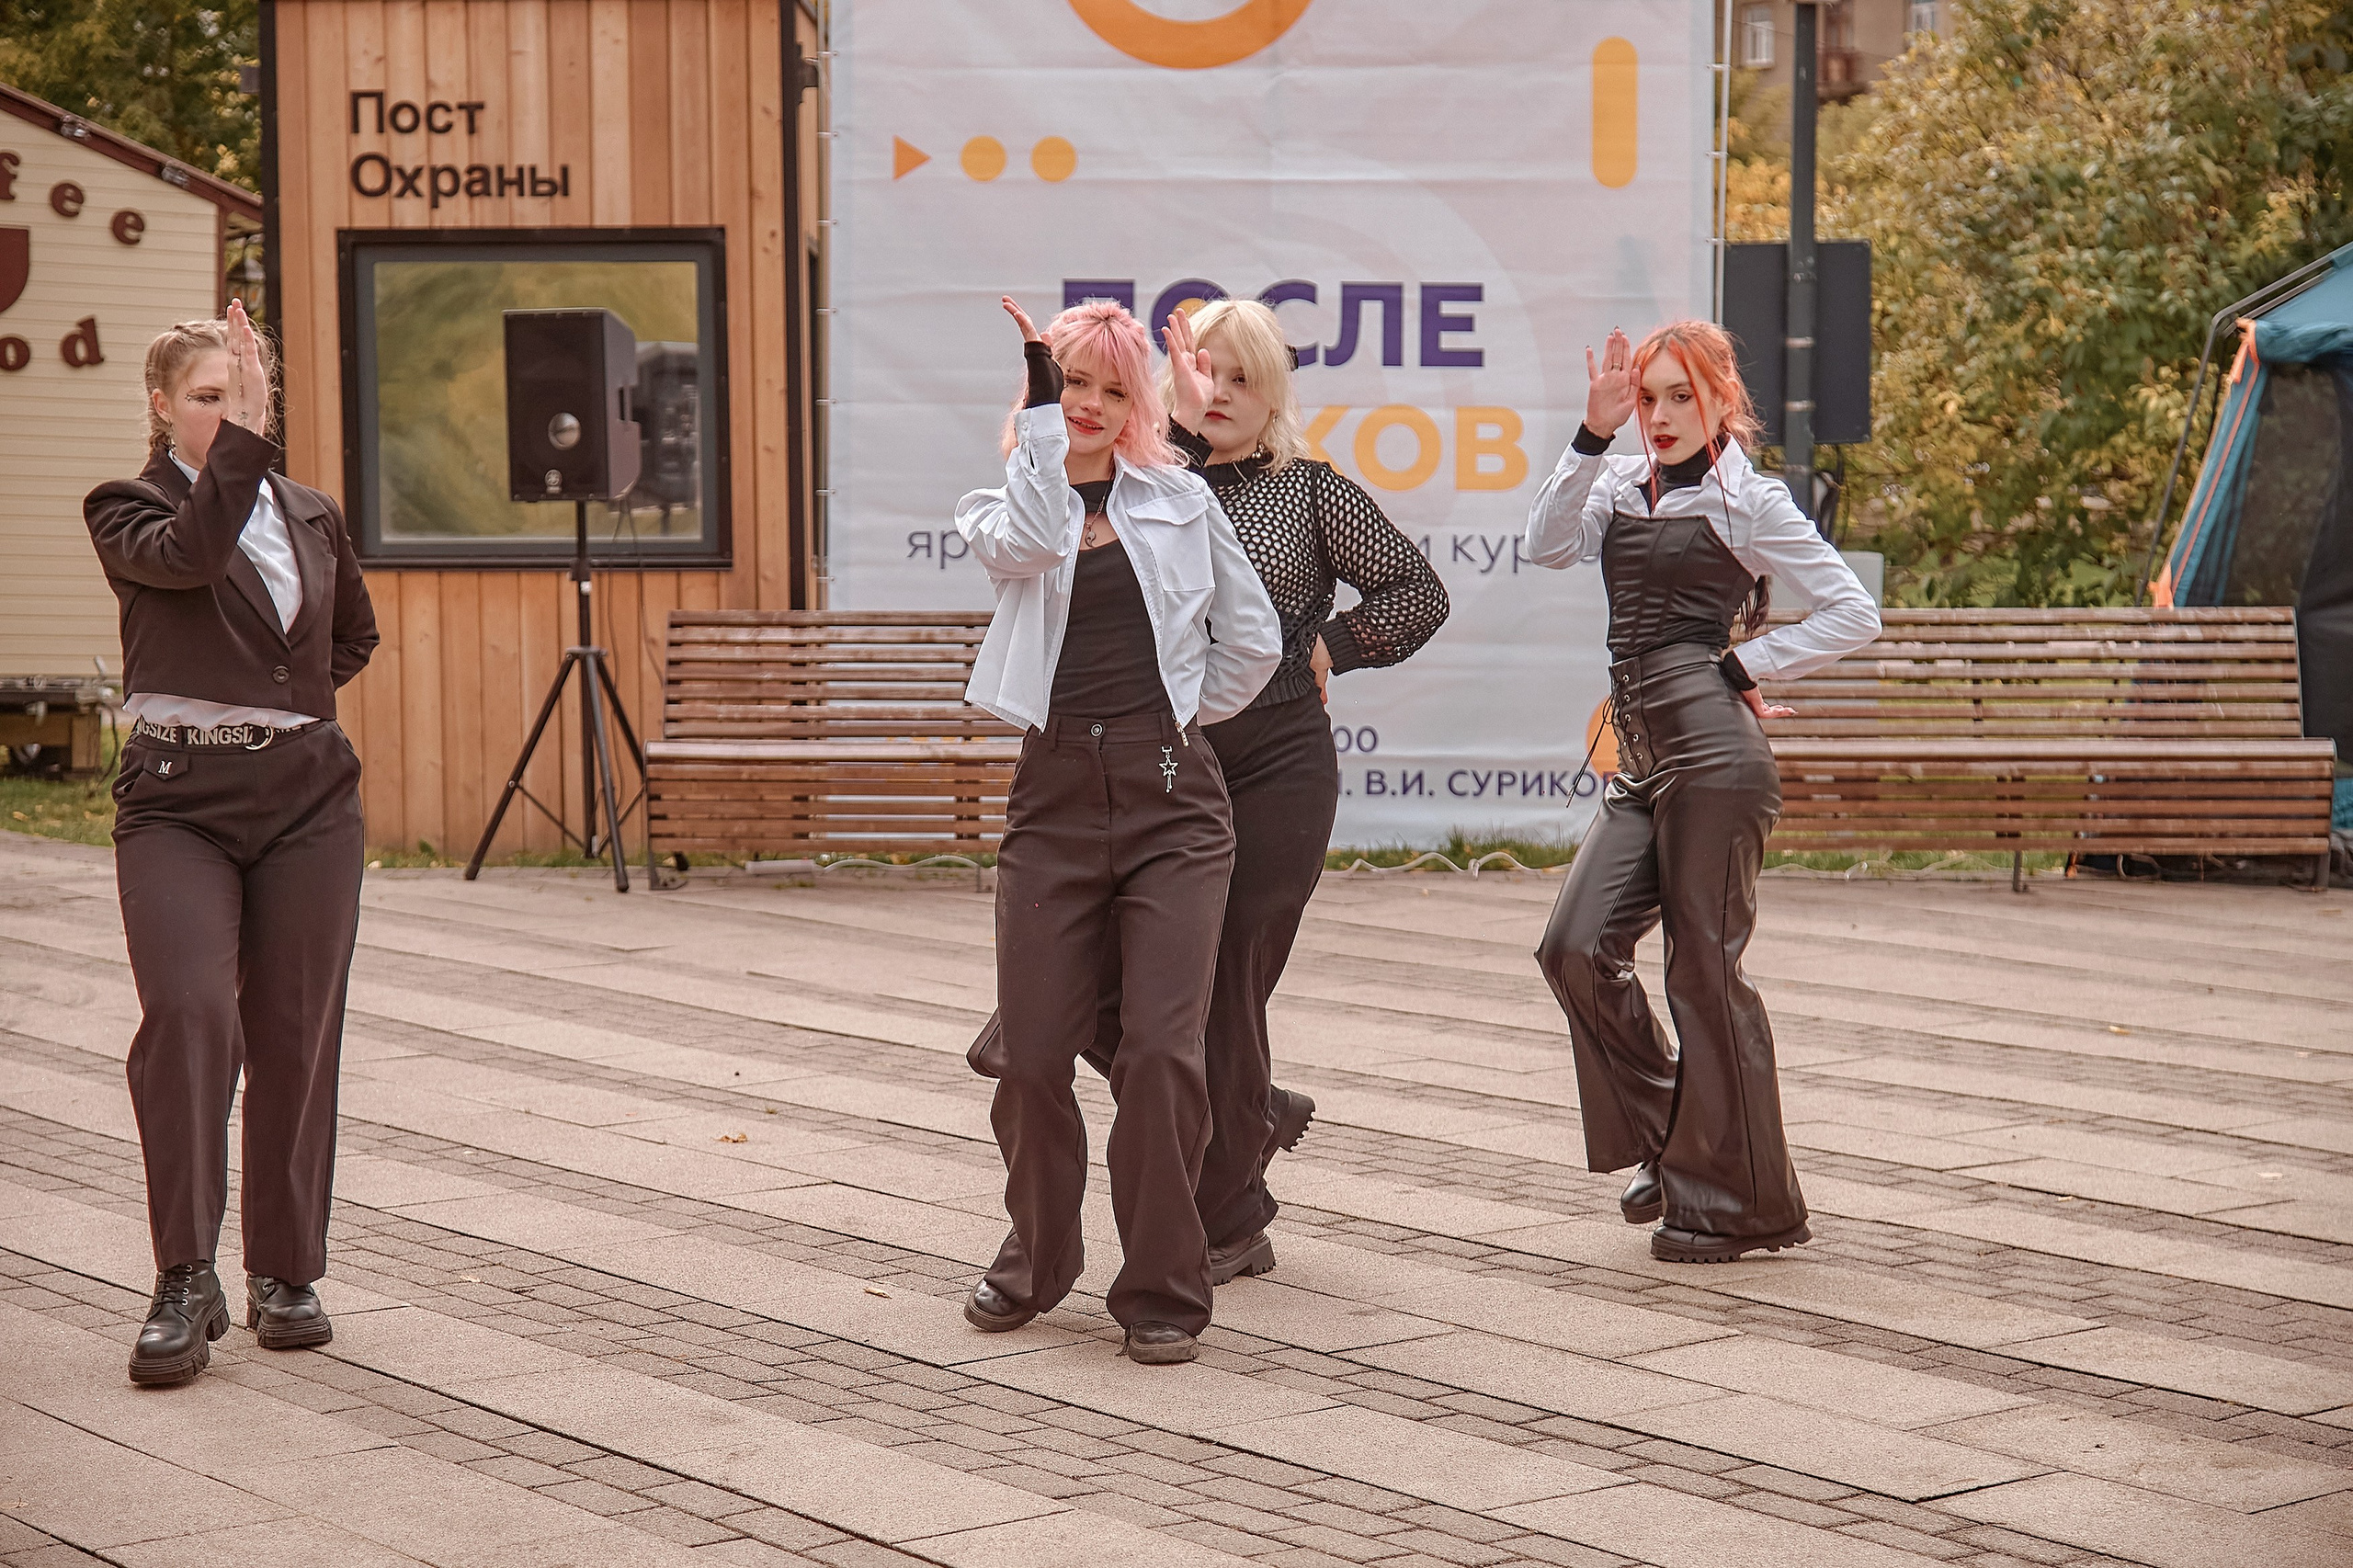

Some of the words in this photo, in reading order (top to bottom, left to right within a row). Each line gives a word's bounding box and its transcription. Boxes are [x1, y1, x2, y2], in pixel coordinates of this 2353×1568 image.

[350, 90, 485, 134] Пост
[350, 152, 570, 209] Охраны
[1365, 769, 1436, 796] В.И.
